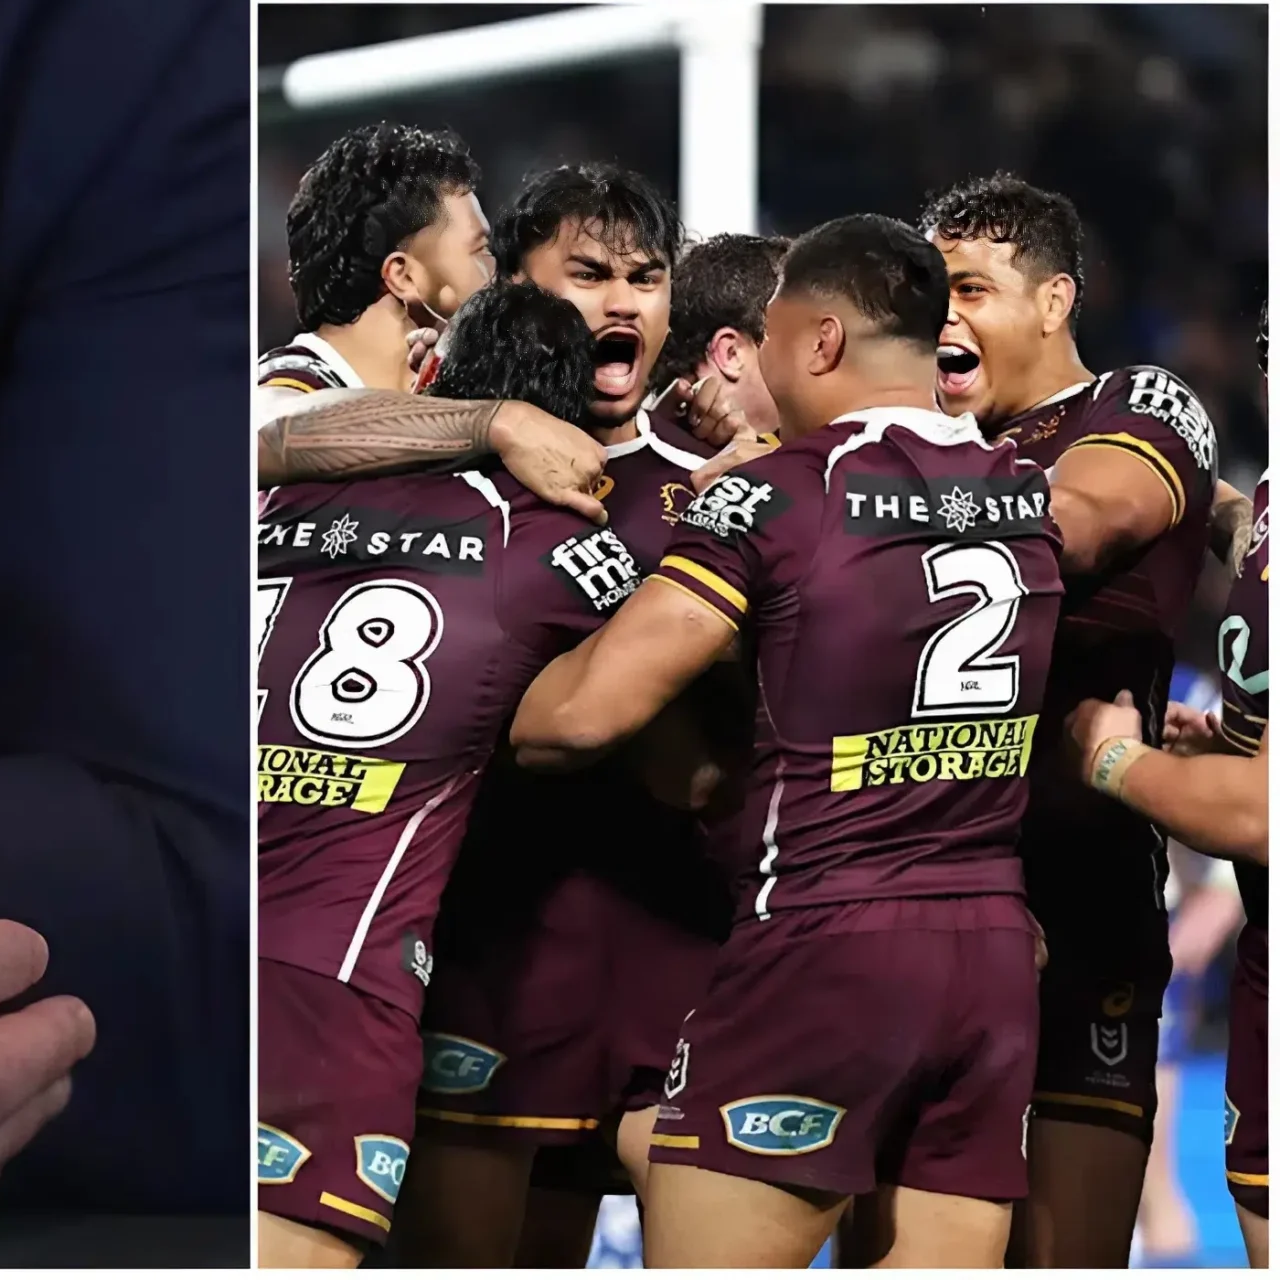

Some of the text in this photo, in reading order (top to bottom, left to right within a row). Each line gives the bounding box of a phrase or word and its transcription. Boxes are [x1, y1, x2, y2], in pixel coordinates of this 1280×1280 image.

[846, 492, 930, 522] THE
[366, 531, 484, 562] STAR
[551, 527, 627, 578] firs
[910, 540, 1030, 719] 2
[258, 748, 368, 780] IONAL
[866, 750, 1021, 787] STORAGE
[738, 1110, 825, 1137] BCF
